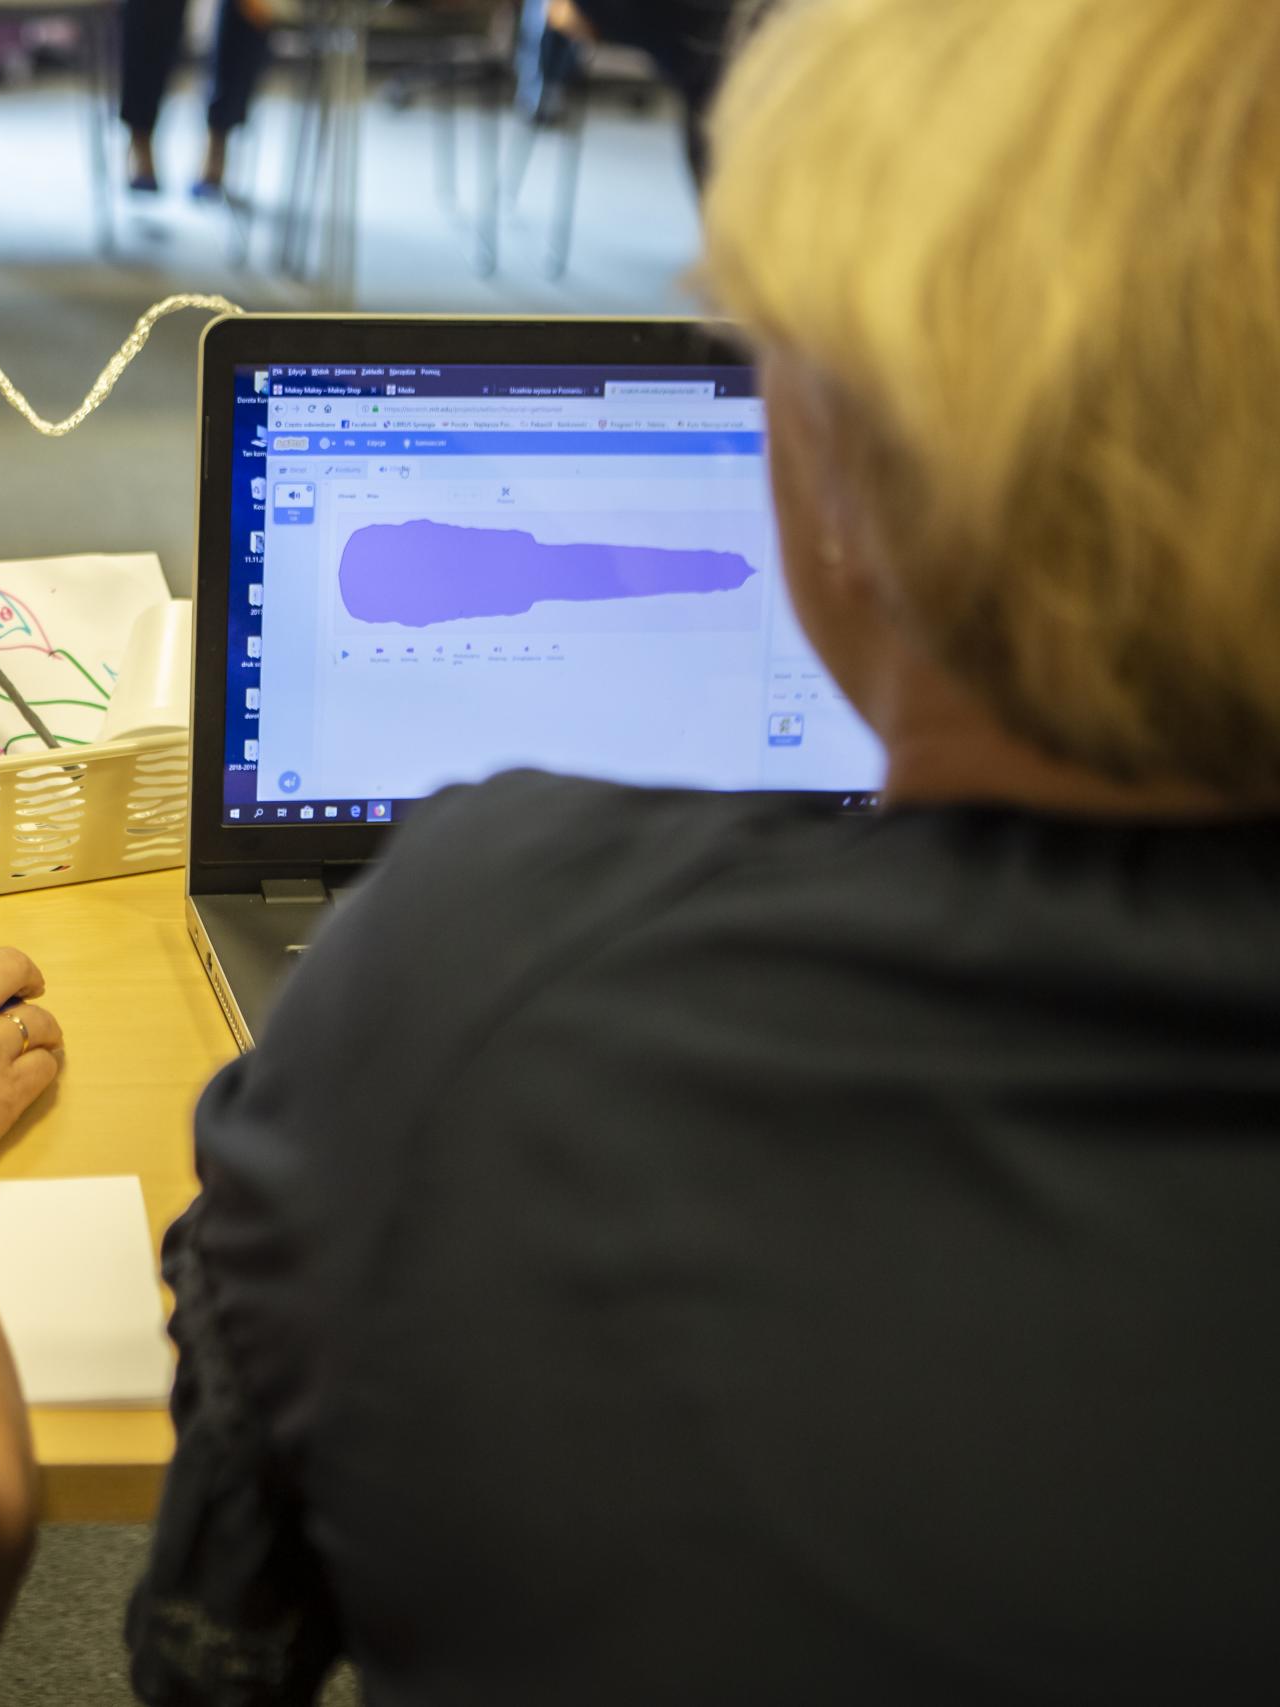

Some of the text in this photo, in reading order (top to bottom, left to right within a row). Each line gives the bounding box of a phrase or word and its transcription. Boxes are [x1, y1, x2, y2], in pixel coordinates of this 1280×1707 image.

[288, 368, 307, 377] Edycja
[334, 368, 357, 377] Historia
[228, 763, 257, 771] 2018-2019
